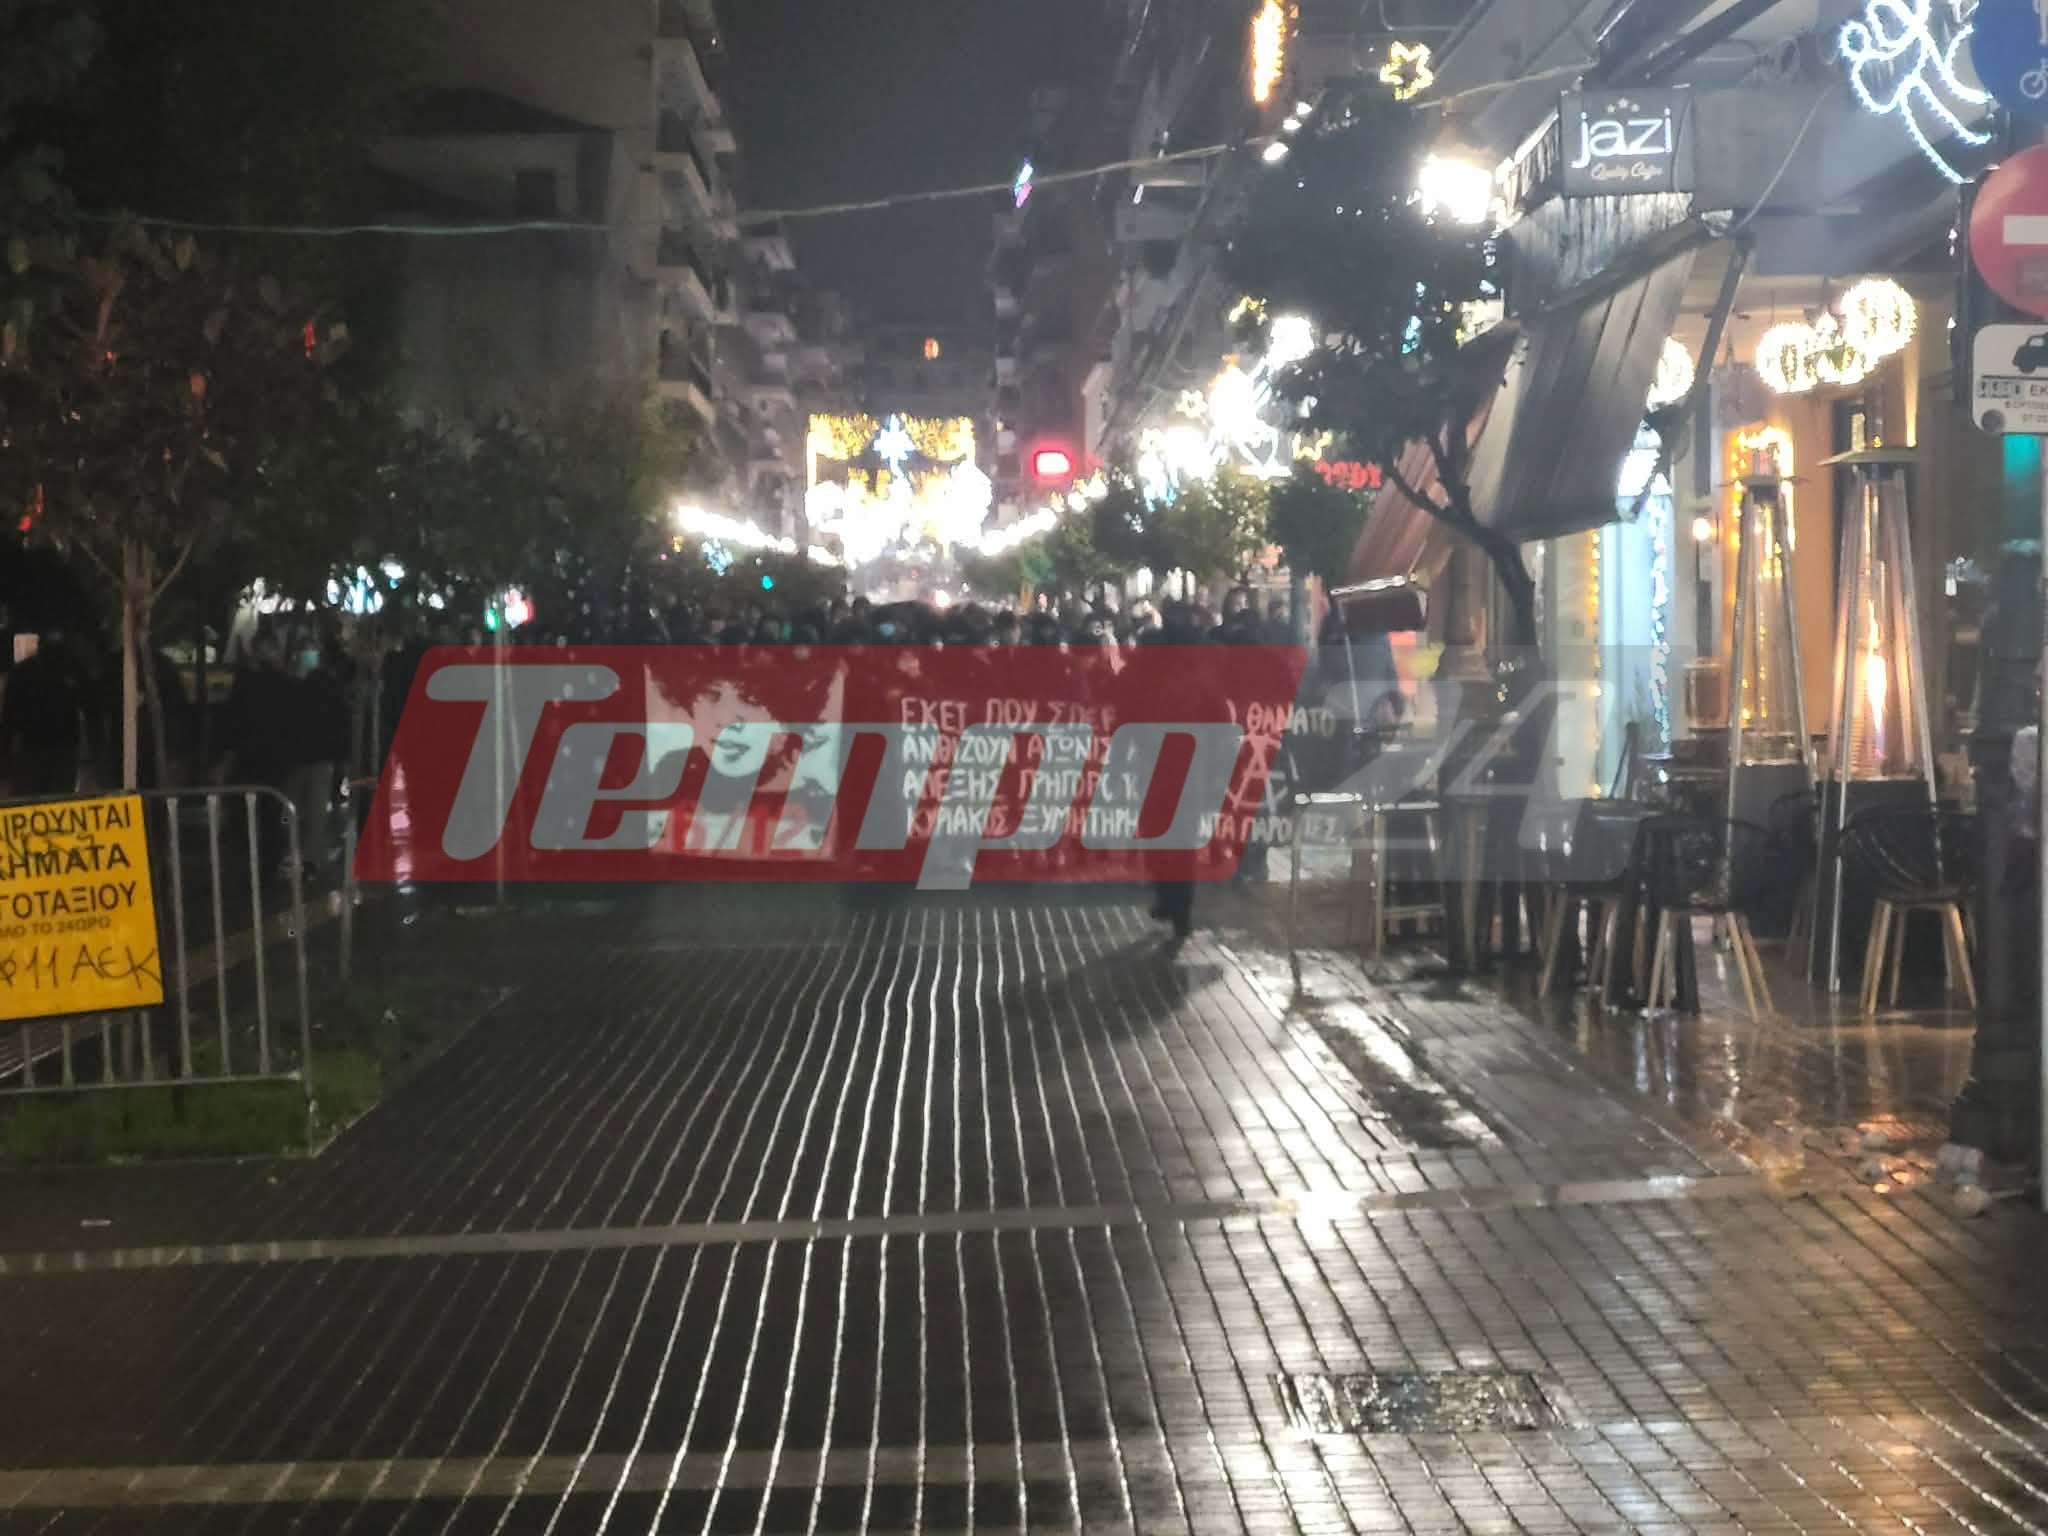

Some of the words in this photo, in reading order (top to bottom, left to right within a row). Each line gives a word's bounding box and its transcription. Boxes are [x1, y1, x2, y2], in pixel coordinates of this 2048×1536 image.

[1570, 107, 1673, 169] jazi
[985, 698, 1037, 729] ΠΟΥ
[0, 802, 130, 842] ΙΡΟΥΝΤΑΙ
